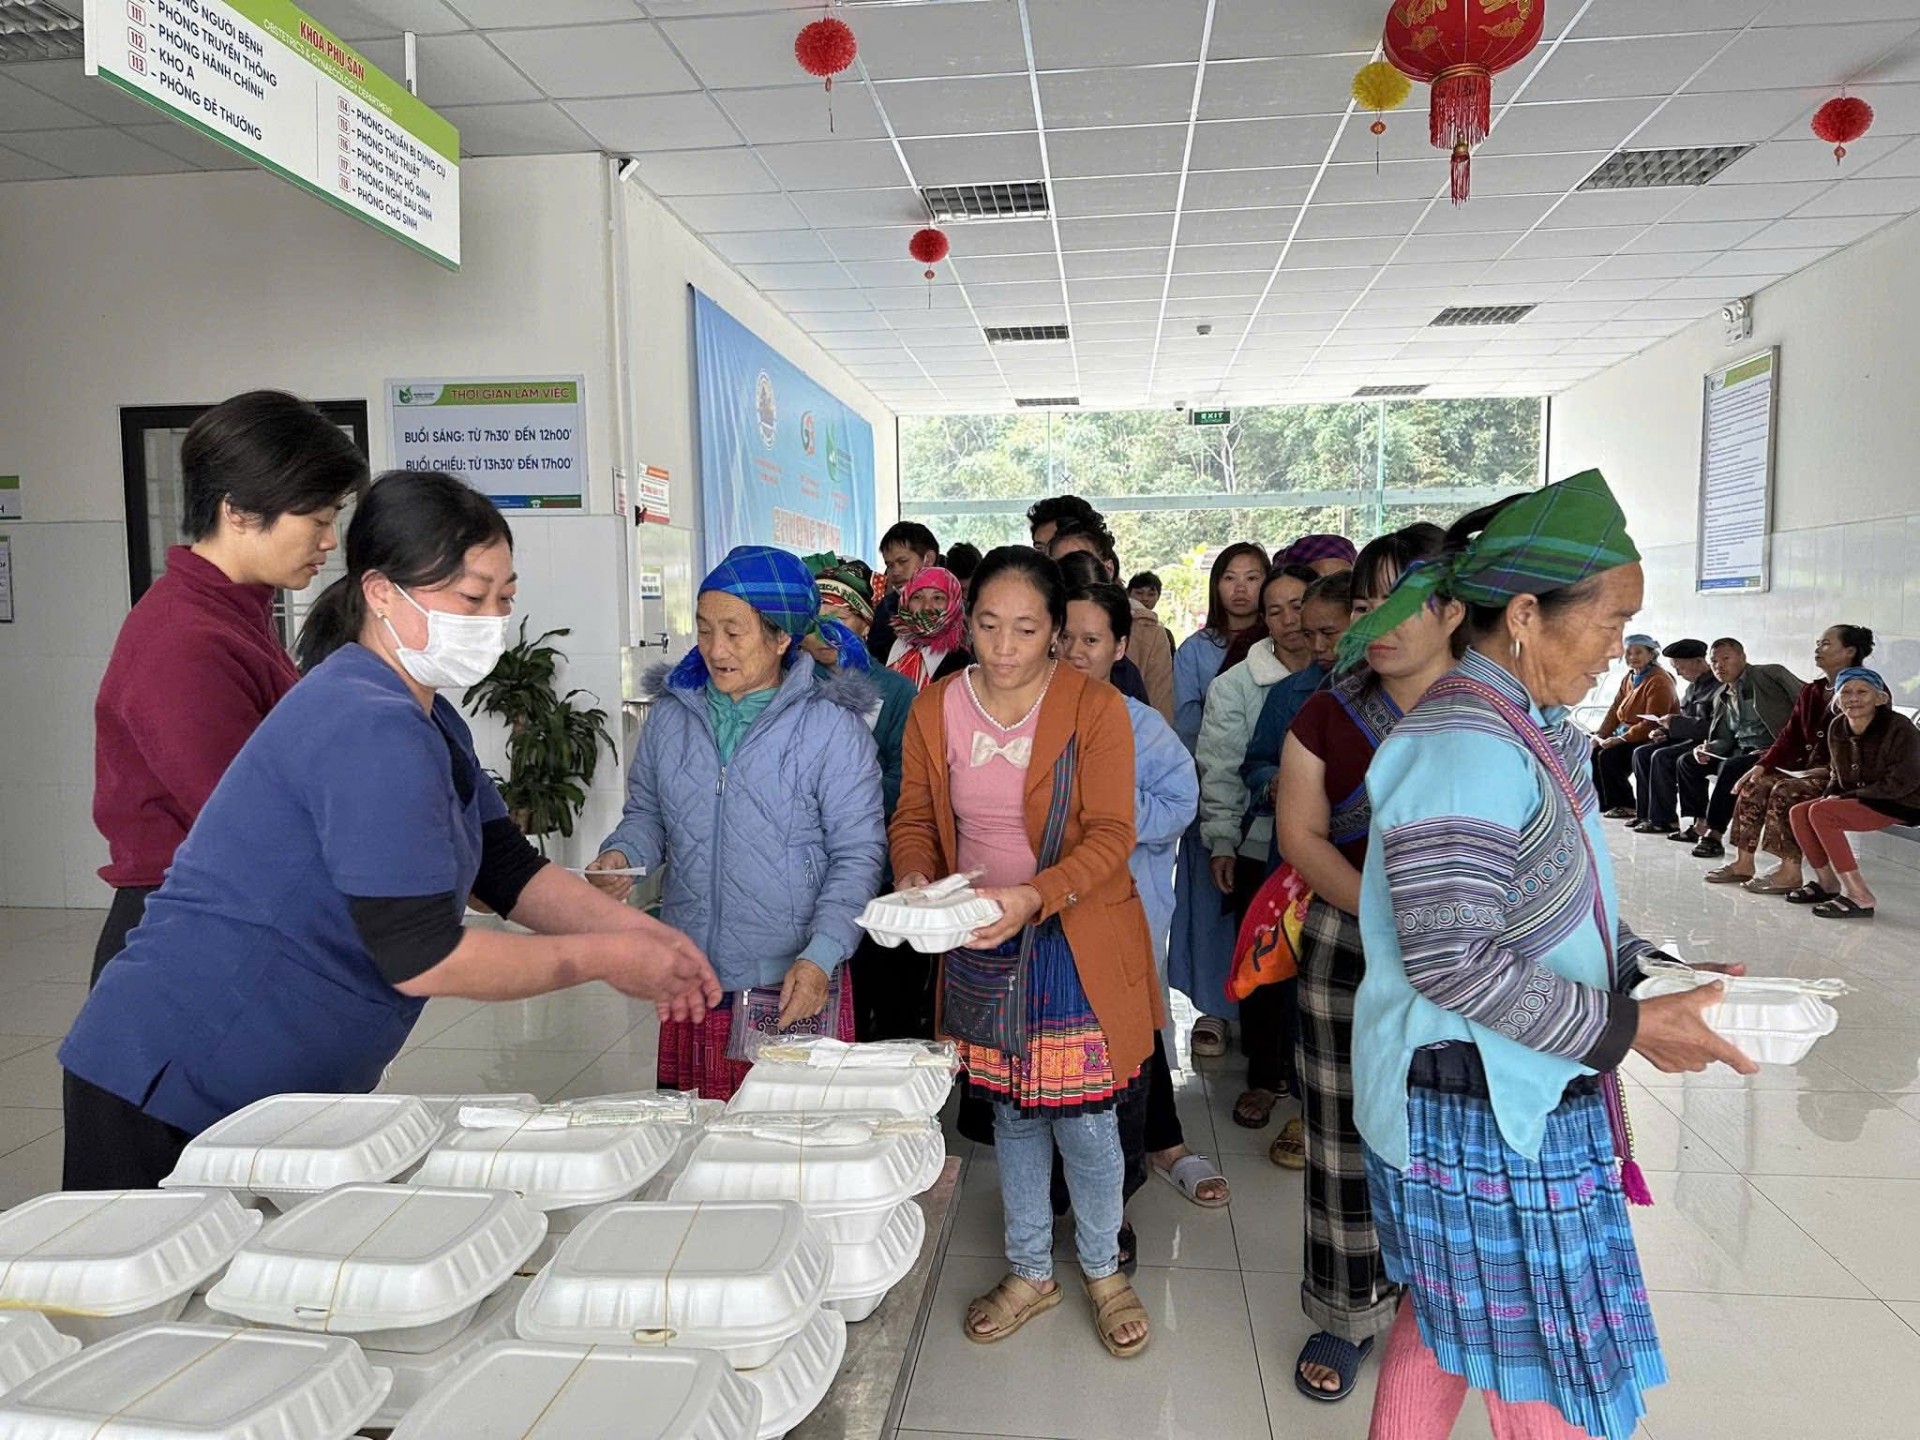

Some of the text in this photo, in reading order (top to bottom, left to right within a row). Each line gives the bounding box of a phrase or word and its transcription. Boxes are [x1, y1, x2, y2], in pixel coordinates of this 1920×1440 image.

[131, 5, 142, 22] 111
[158, 23, 200, 60] PHÒNG
[202, 51, 232, 81] HÀNH
[233, 71, 264, 101] CHÍNH
[158, 0, 200, 36] PHÒNG
[201, 28, 241, 64] TRUYỀN
[243, 56, 278, 87] THÔNG
[201, 7, 263, 58] NGƯỜI BỆNH
[300, 20, 325, 53] KHOA
[131, 31, 143, 49] 112
[159, 47, 184, 73] KHO
[186, 65, 195, 81] A
[131, 55, 144, 72] 113
[160, 71, 200, 106] PHÒNG
[203, 97, 218, 117] ĐẺ
[219, 106, 262, 141] THƯỜNG
[356, 108, 383, 135] PHÒNG
[356, 128, 383, 154] PHÒNG
[357, 147, 384, 173] PHÒNG
[416, 185, 431, 203] SINH
[357, 167, 384, 192] PHÒNG
[404, 195, 417, 212] SAU
[417, 204, 433, 222] SINH
[357, 186, 384, 211] PHÒNG
[402, 213, 418, 231] SINH
[481, 388, 511, 400] GIAN
[1200, 412, 1224, 420] EXIT
[404, 425, 429, 443] BUỔI
[432, 427, 465, 443] SÁNG:
[467, 427, 482, 442] TỪ
[514, 425, 536, 442] ĐẾN
[467, 455, 482, 471] TỪ
[517, 453, 539, 470] ĐẾN
